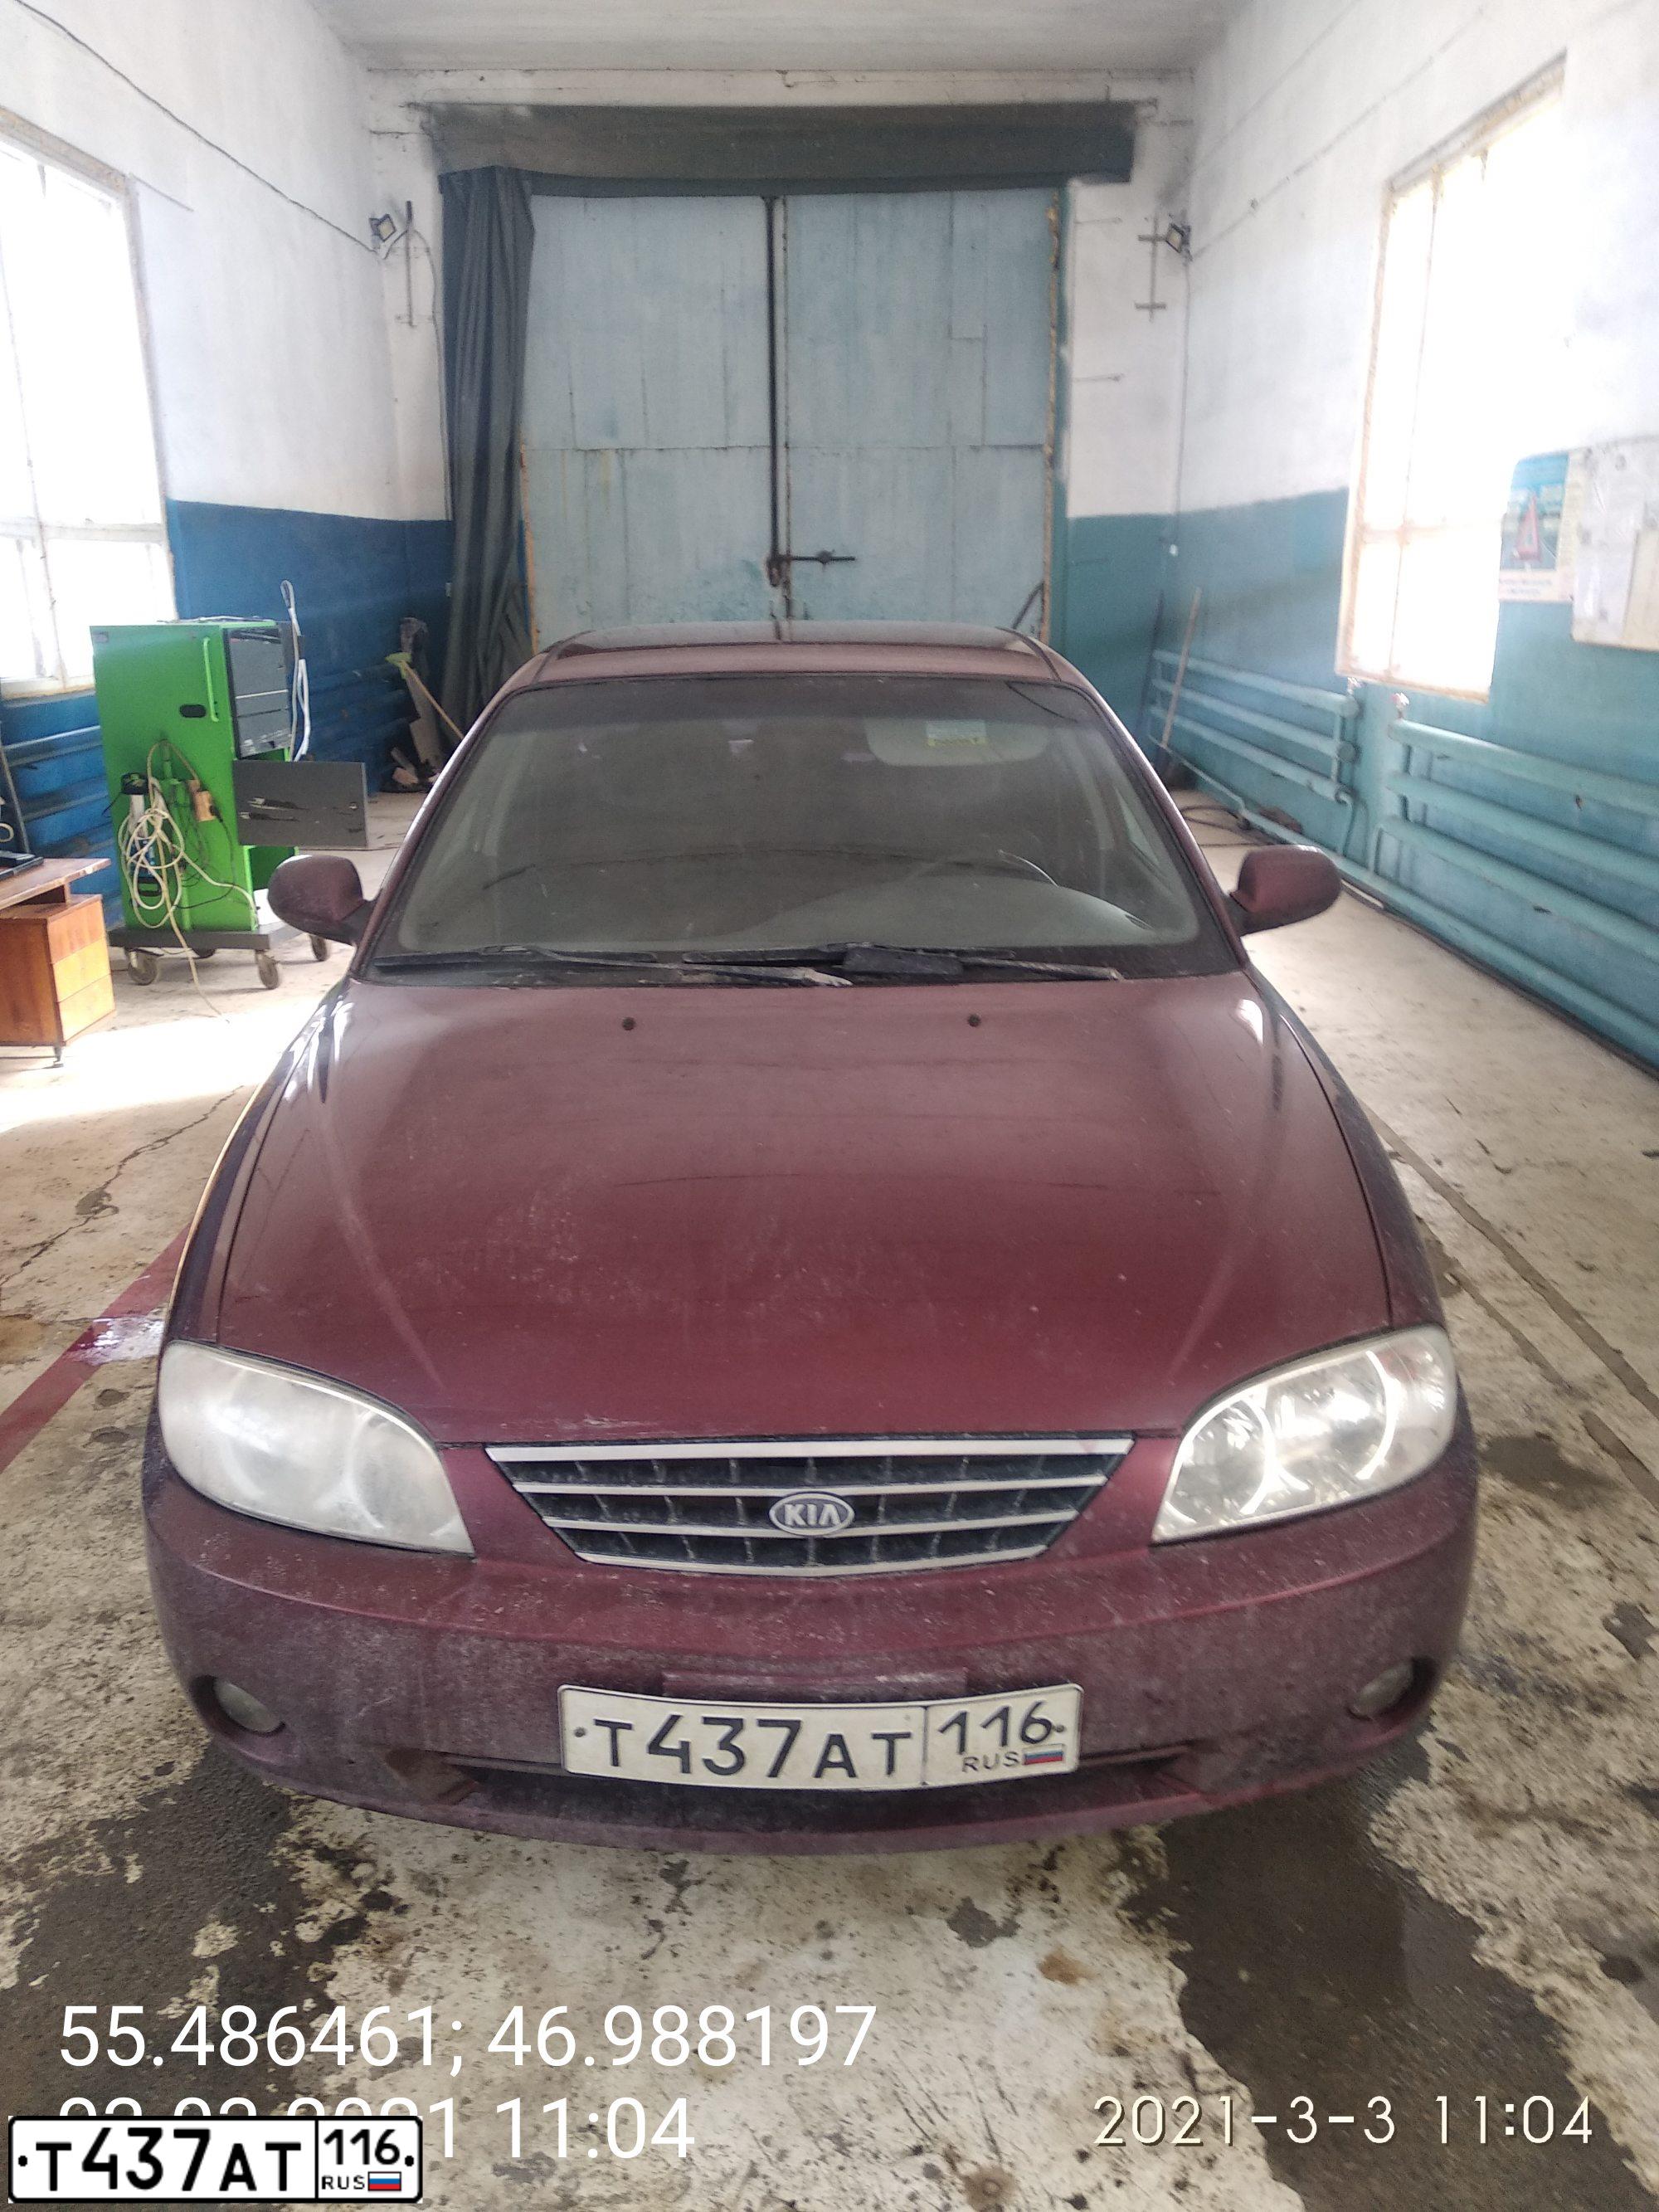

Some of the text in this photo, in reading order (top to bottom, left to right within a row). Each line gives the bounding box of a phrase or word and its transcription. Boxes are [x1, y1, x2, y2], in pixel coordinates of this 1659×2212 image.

[784, 1503, 841, 1526] KIA
[938, 1701, 1053, 1756] 116
[961, 1752, 1020, 1774] RUS
